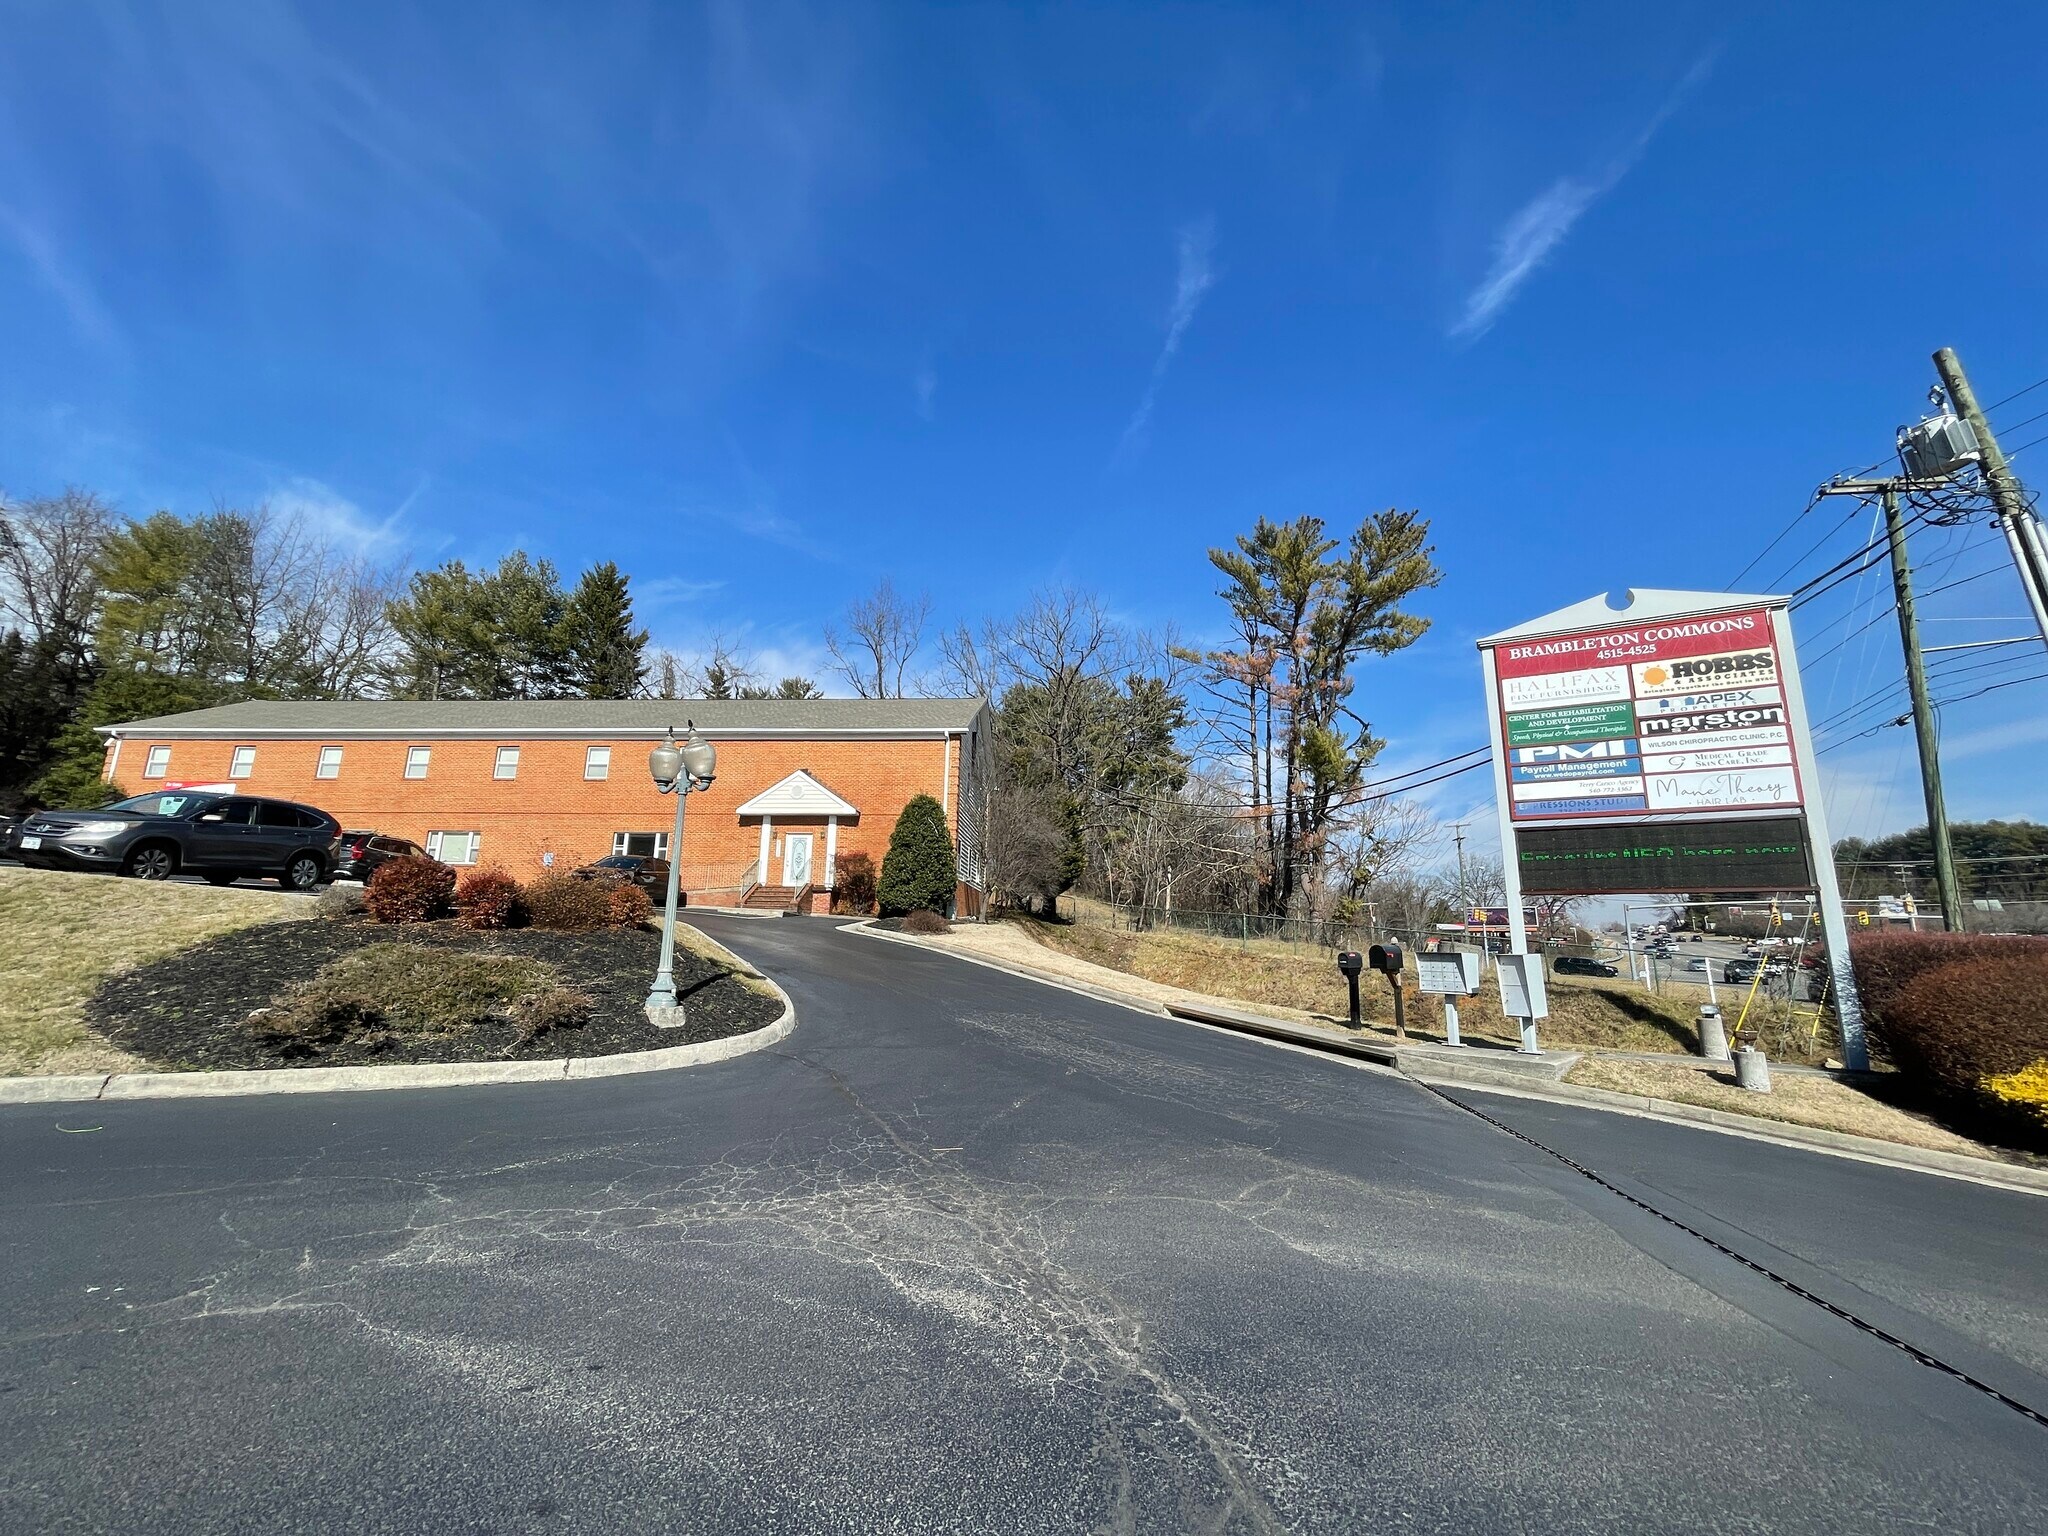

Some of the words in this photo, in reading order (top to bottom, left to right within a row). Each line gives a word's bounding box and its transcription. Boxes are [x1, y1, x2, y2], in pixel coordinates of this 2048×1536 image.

[1510, 632, 1639, 660] BRAMBLETON
[1644, 616, 1754, 642] COMMONS
[1597, 644, 1656, 659] 4515-4525
[1670, 652, 1773, 678] HOBBS
[1510, 671, 1616, 693] HALIFAX
[1689, 669, 1774, 683] ASSOCIATES
[1540, 684, 1620, 698] FURNISHINGS
[1696, 691, 1755, 704] APEX
[1509, 713, 1540, 721] CENTER
[1558, 705, 1626, 717] REHABILITATION
[1660, 700, 1757, 713] PROPERTIES
[1547, 715, 1606, 726] DEVELOPMENT
[1640, 706, 1785, 735] marston
[1671, 721, 1752, 733] SALON
[1564, 728, 1598, 736] Occupational
[1648, 739, 1677, 748] WILSON
[1679, 735, 1737, 745] CHIROPRACTIC
[1519, 740, 1626, 762] PMI
[1521, 765, 1554, 775] Payroll
[1558, 760, 1628, 771] Management
[1534, 769, 1615, 779] www.wedopayroll.com
[1656, 778, 1718, 797] Mane
[1717, 773, 1787, 800] Theory
[1519, 799, 1591, 810] EPRESSIONS
[1594, 798, 1638, 806] STUDI
